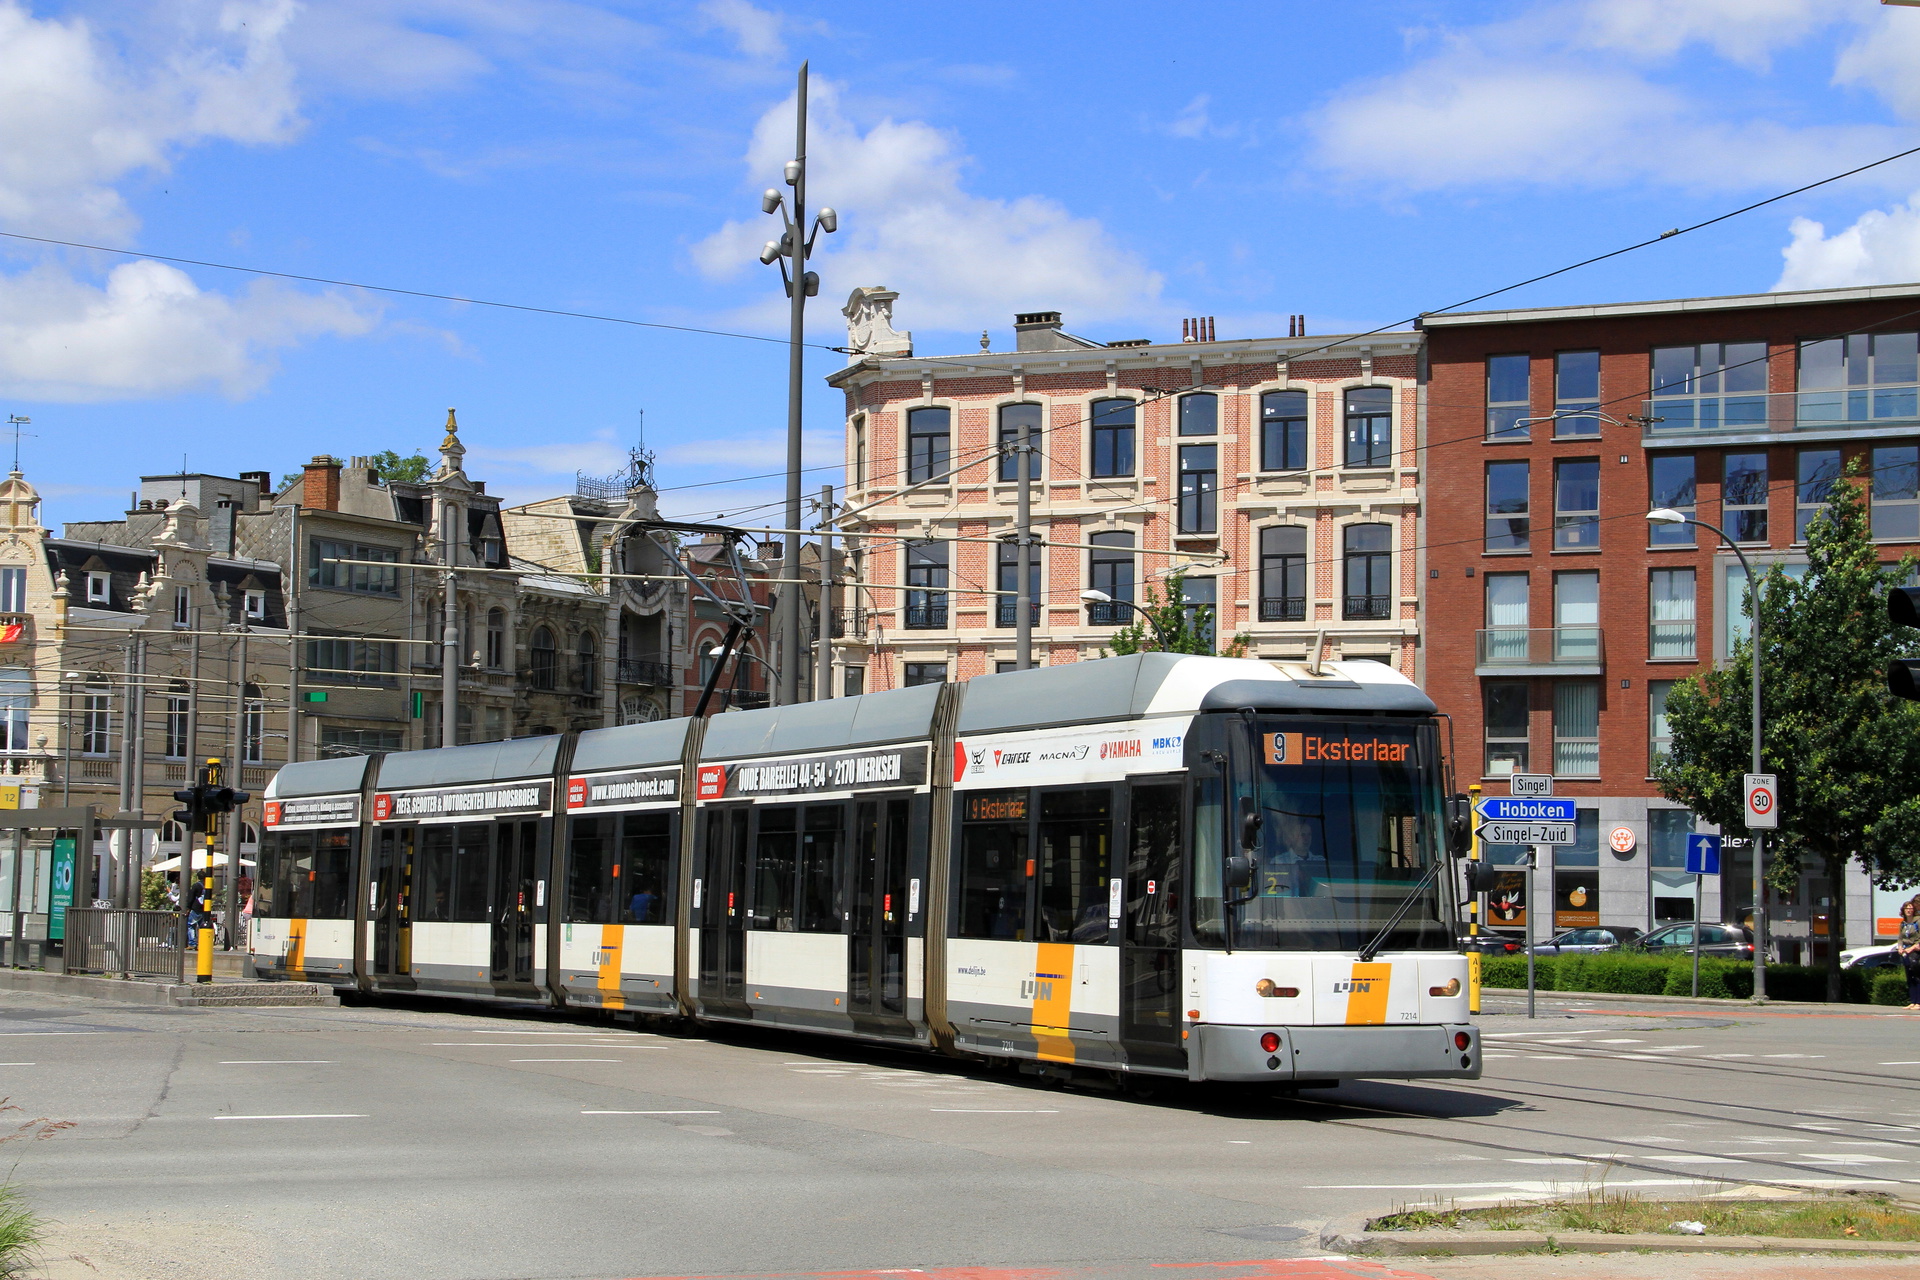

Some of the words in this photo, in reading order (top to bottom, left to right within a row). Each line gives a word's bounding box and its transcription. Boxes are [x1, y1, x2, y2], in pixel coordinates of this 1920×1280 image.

[1108, 739, 1141, 759] YAMAHA
[1153, 737, 1171, 749] MBK
[1274, 733, 1286, 762] 9
[1305, 737, 1409, 761] Eksterlaar
[1039, 751, 1076, 761] MACNA
[739, 768, 759, 791] OUDE
[799, 761, 825, 788] 44-54
[834, 759, 855, 785] 2170
[856, 754, 901, 783] MERKSEM
[591, 778, 675, 801] www.vanroosbroeck.com
[1517, 778, 1547, 794] Singel
[5, 793, 15, 802] 12
[377, 798, 386, 809] sinds
[396, 797, 411, 815] FIETS,
[412, 795, 438, 814] SCOOTER
[438, 798, 442, 812] &
[443, 792, 484, 812] MOTORCENTER
[485, 791, 497, 809] VAN
[497, 788, 539, 808] ROOSBROECK
[570, 793, 583, 803] ONLINE
[1754, 795, 1768, 807] 30
[972, 799, 978, 819] 9
[981, 797, 1024, 819] Eksterlaar
[1500, 801, 1564, 817] Hoboken
[1494, 826, 1566, 844] Singel-Zuid
[55, 860, 71, 891] 50
[1267, 877, 1277, 895] 2
[957, 966, 986, 977] www.delijn.be
[1020, 980, 1052, 1001] LIJN
[1333, 982, 1370, 993] LIJN
[1400, 1012, 1417, 1020] 7214
[1001, 1040, 1014, 1052] 7214
